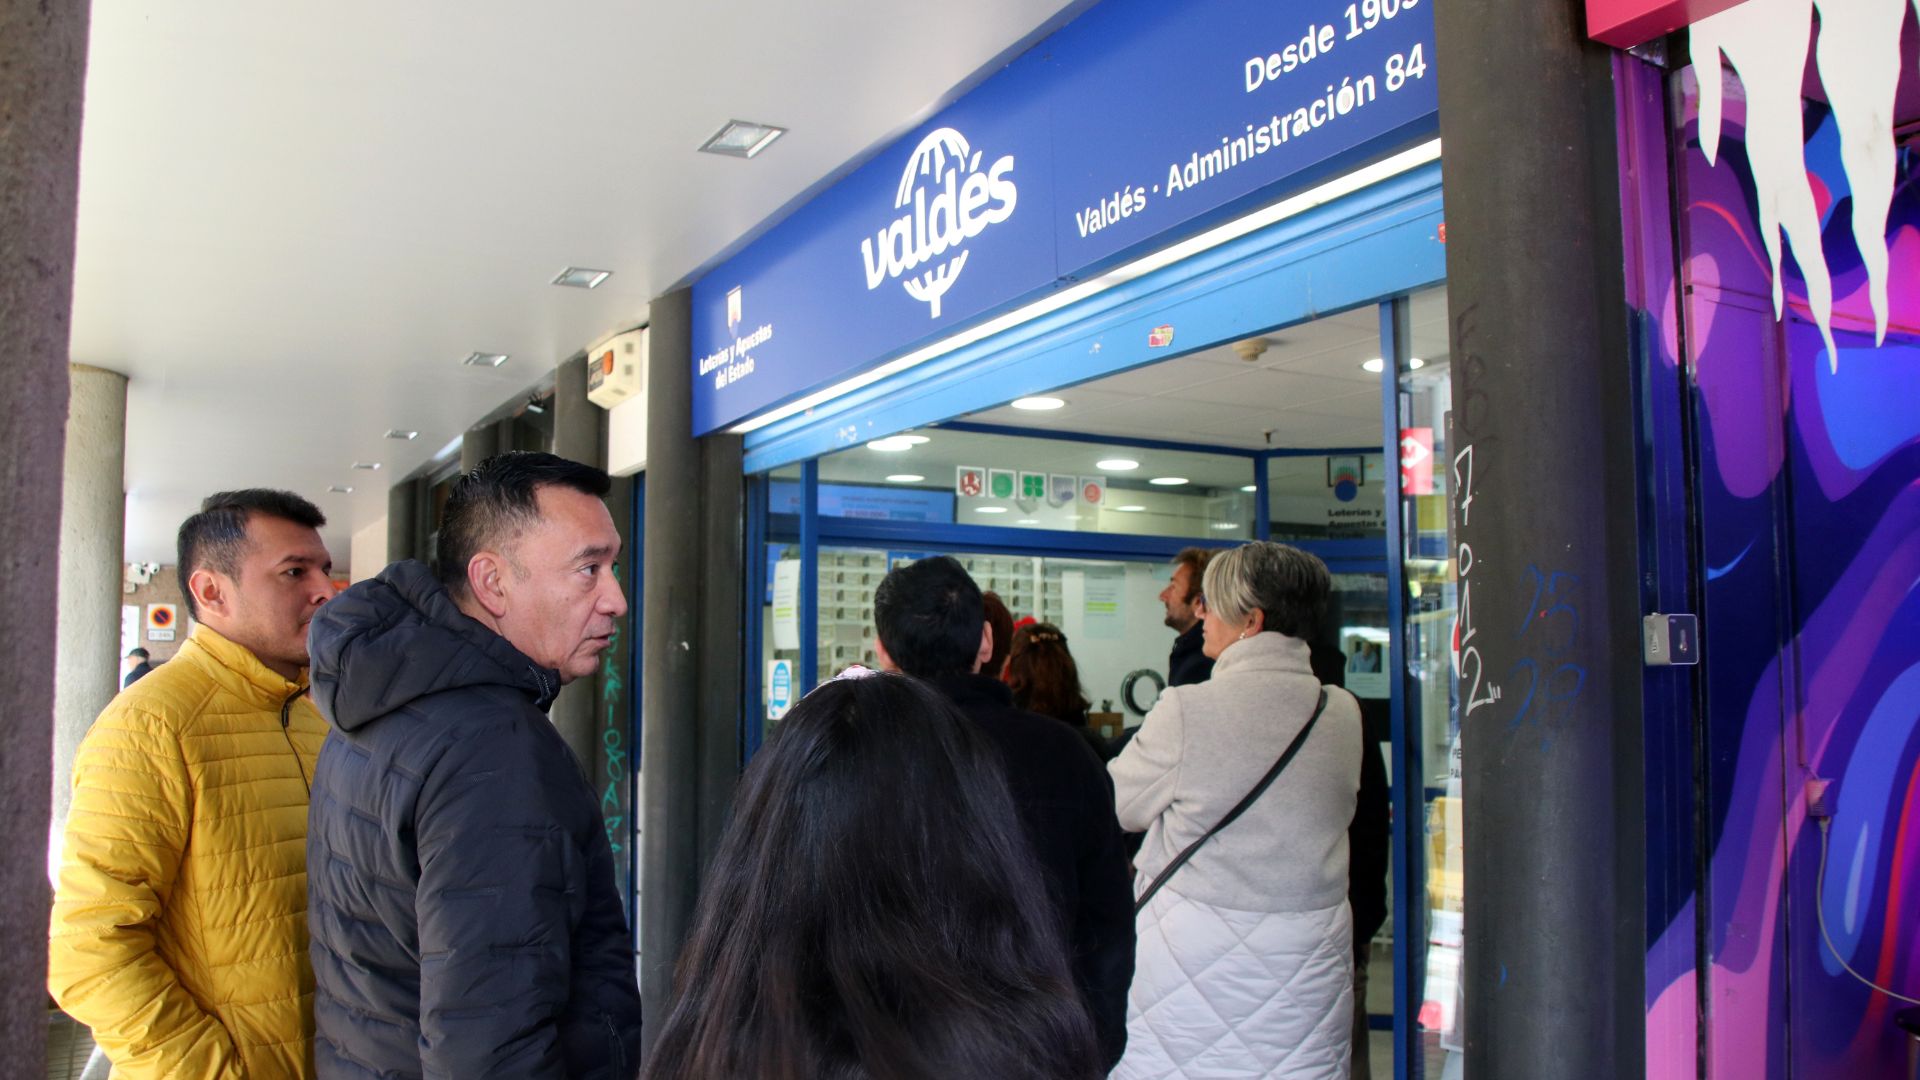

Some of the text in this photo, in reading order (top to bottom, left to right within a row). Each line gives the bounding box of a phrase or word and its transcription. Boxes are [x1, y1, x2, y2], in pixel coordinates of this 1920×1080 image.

[1245, 0, 1419, 92] Desde 190
[1075, 184, 1146, 238] Valdés
[1165, 75, 1376, 198] Administración
[1385, 42, 1427, 92] 84
[861, 150, 1017, 290] valdés
